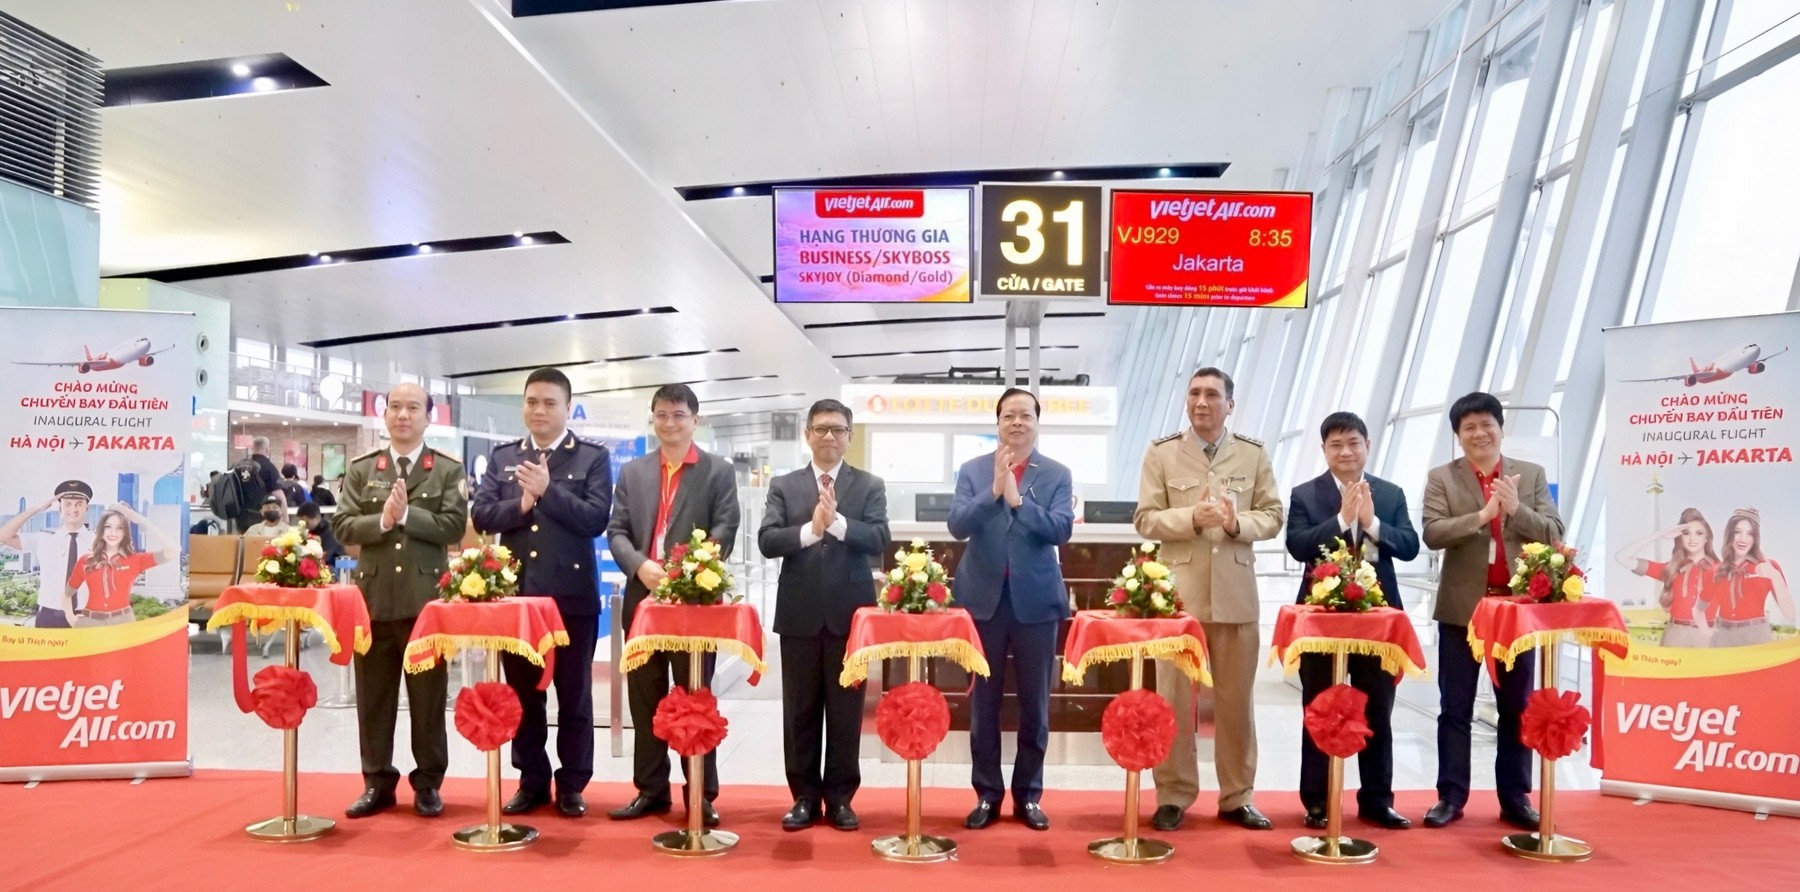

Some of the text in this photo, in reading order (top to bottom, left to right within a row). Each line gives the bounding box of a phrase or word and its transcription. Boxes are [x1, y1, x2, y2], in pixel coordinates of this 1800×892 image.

[800, 228, 950, 247] HẠNG THƯƠNG GIA
[1000, 199, 1084, 265] 31
[1117, 226, 1180, 244] VJ929
[1249, 229, 1292, 247] 8:35
[800, 249, 950, 268] BUSINESS/SKYBOSS
[1172, 254, 1244, 272] Jakarta
[799, 270, 953, 285] SKYJOY (Diamond/Gold)
[997, 273, 1030, 291] CỬA
[1042, 278, 1085, 291] GATE
[54, 380, 92, 393] CHÀO
[79, 399, 105, 409] BAY
[964, 394, 998, 414] DU
[1661, 393, 1700, 407] CHÀO
[34, 415, 153, 428] INAUGURAL FLIGHT
[1686, 412, 1714, 423] BAY
[10, 434, 175, 452] HÀ NỘI JAKARTA
[1642, 428, 1767, 442] INAUGURAL FLIGHT
[1621, 447, 1793, 468] HÀ NỘI JAKARTA
